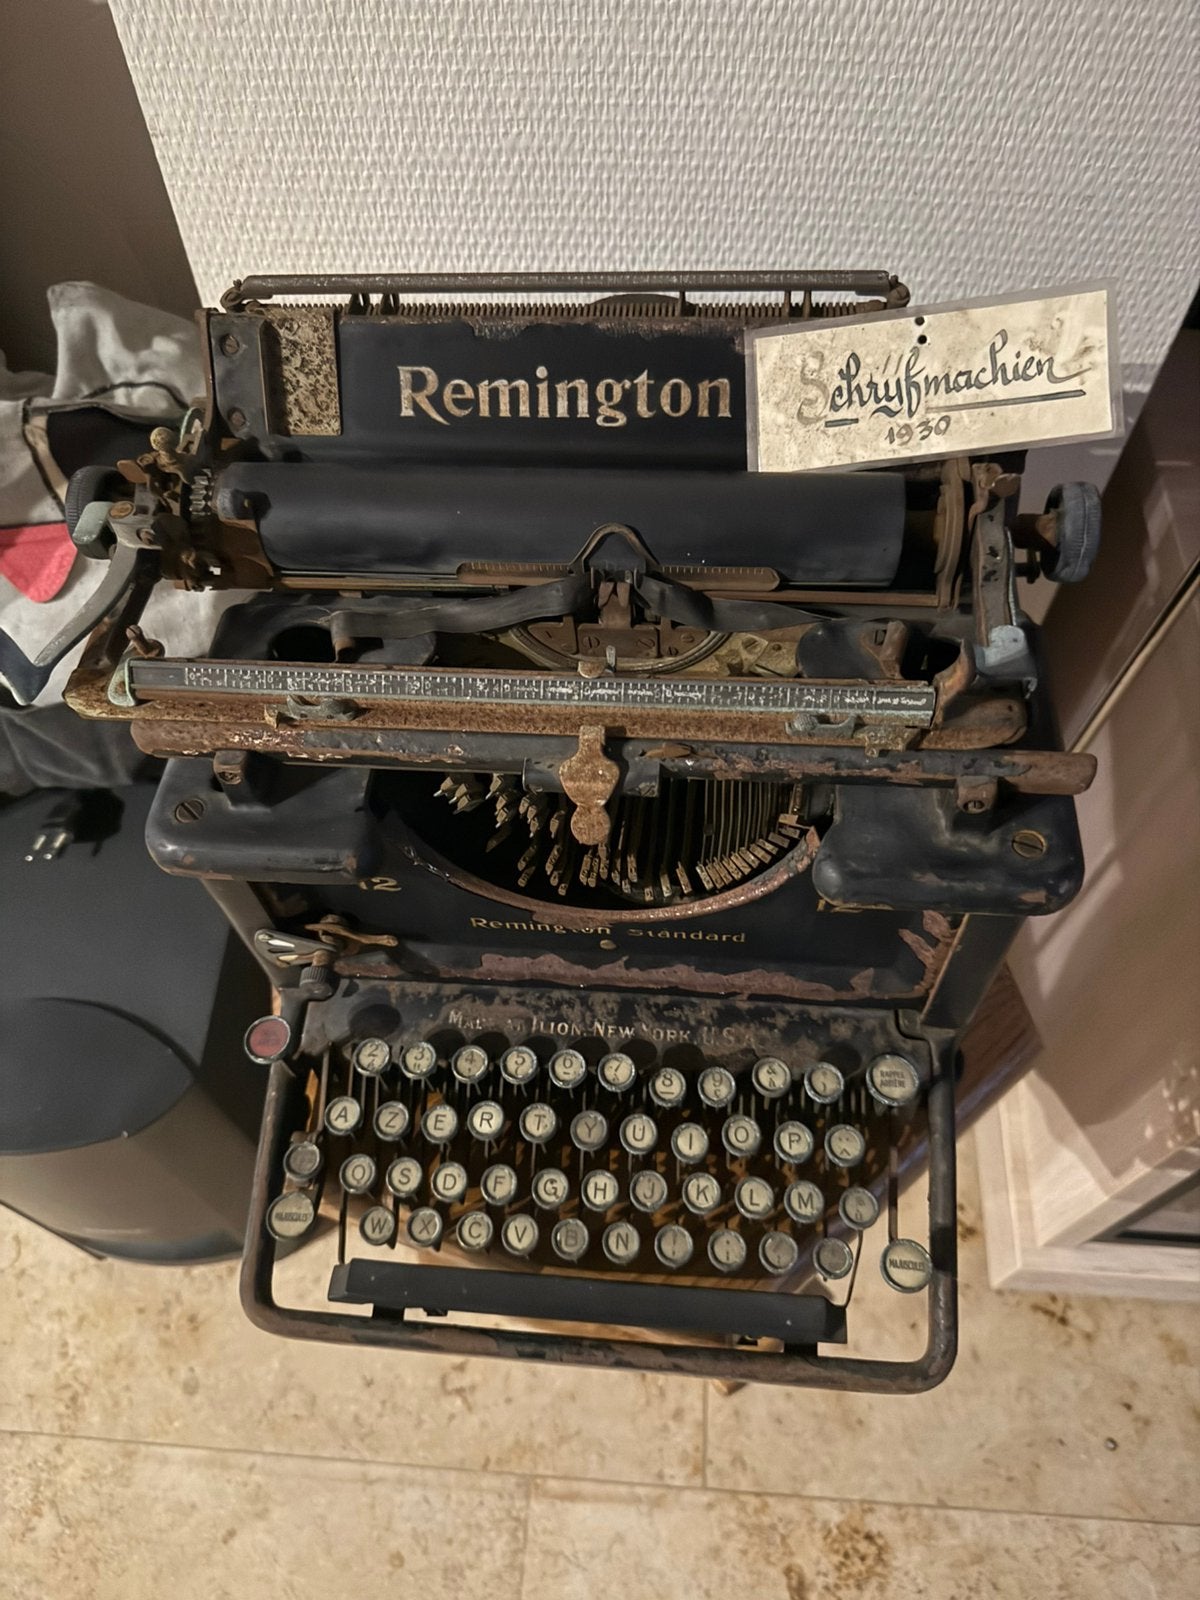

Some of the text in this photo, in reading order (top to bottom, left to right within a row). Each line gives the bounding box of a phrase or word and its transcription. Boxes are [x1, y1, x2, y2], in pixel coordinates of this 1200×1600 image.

[397, 366, 732, 427] Remington
[885, 415, 951, 446] 1930
[628, 928, 746, 943] Standard
[334, 1105, 348, 1123] A
[385, 1111, 399, 1129] Z
[433, 1113, 447, 1131] E
[479, 1111, 494, 1129] R
[533, 1113, 547, 1131] T
[584, 1120, 598, 1138] Y
[632, 1124, 646, 1142] U
[734, 1126, 750, 1144] O
[788, 1132, 801, 1150] P
[351, 1163, 814, 1211] Q S D F G H J K L M
[370, 1216, 388, 1235] W
[418, 1218, 432, 1236] X
[467, 1220, 482, 1240] C
[513, 1225, 527, 1244] V
[615, 1231, 630, 1251] N
